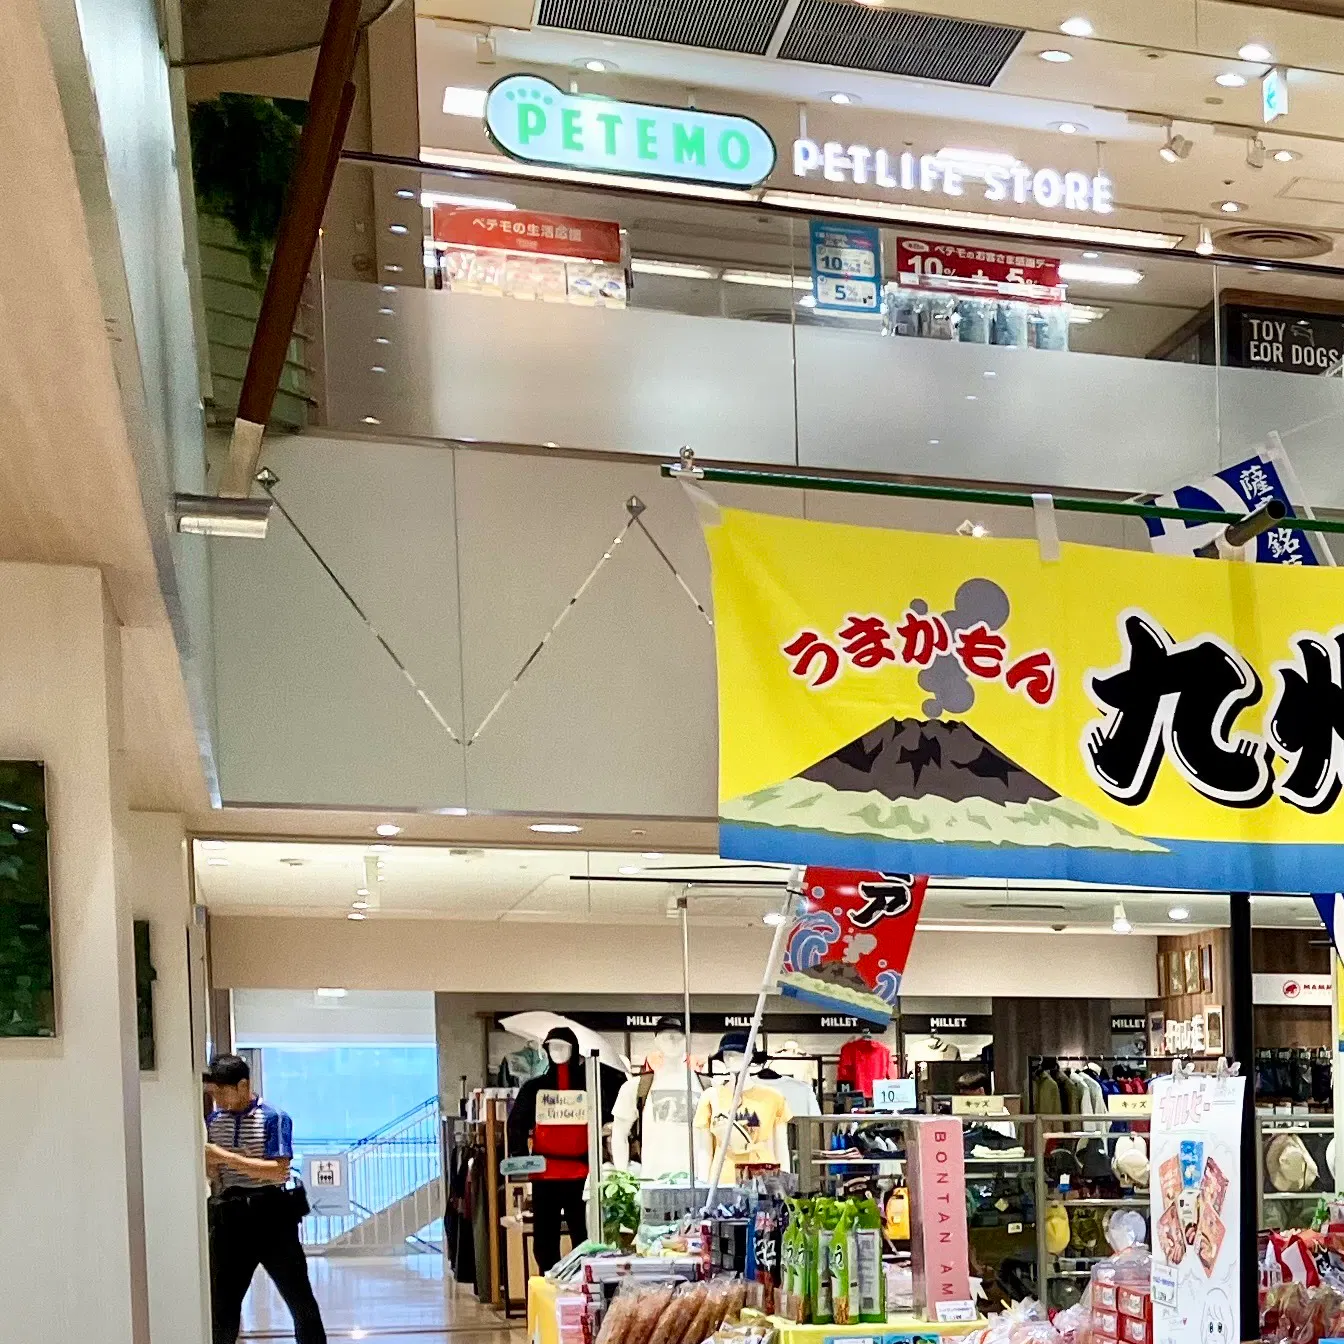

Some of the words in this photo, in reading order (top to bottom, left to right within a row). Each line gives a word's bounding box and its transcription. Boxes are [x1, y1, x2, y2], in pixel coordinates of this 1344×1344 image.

[517, 103, 751, 170] PETEMO
[793, 139, 963, 196] PETLIFE
[984, 167, 1113, 213] STORE
[1250, 319, 1286, 341] TOY
[1292, 345, 1342, 368] DOGS
[781, 611, 1056, 707] うまかもん
[626, 1015, 663, 1026] MILLE
[821, 1016, 858, 1027] MILLET
[930, 1017, 966, 1028] MILLET
[1112, 1018, 1146, 1029] MILLET
[934, 1130, 953, 1244] BONTAN
